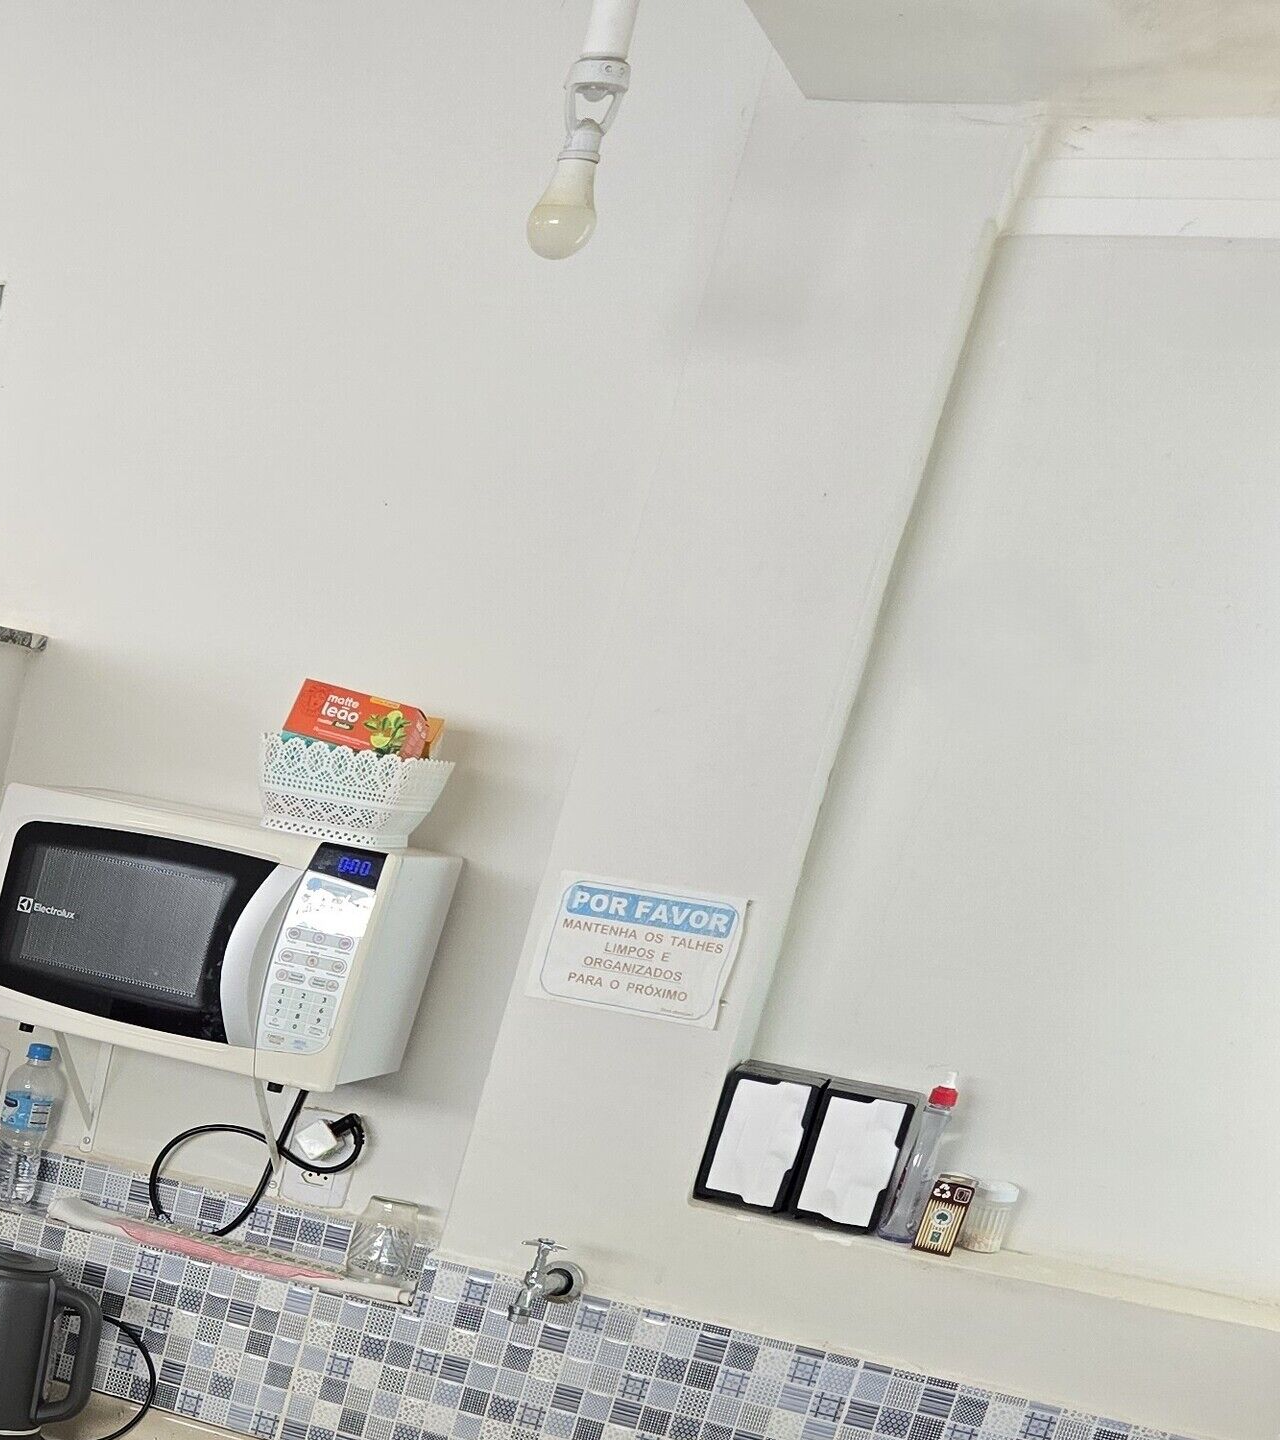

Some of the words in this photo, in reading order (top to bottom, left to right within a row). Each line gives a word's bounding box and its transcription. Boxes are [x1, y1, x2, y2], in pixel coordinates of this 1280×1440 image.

[321, 702, 359, 723] leão
[327, 694, 360, 709] matte
[33, 902, 75, 919] Electrolux
[571, 890, 628, 917] POR
[635, 901, 729, 932] FAVOR
[563, 918, 637, 940] MANTENHA
[644, 931, 664, 944] OS
[670, 935, 724, 954] TALHES
[604, 942, 655, 959] LIMPOS
[661, 952, 670, 962] E
[583, 955, 683, 982] ORGANIZADOS
[567, 971, 603, 987] PARA
[610, 979, 620, 990] O
[626, 982, 688, 1003] PRÓXIMO
